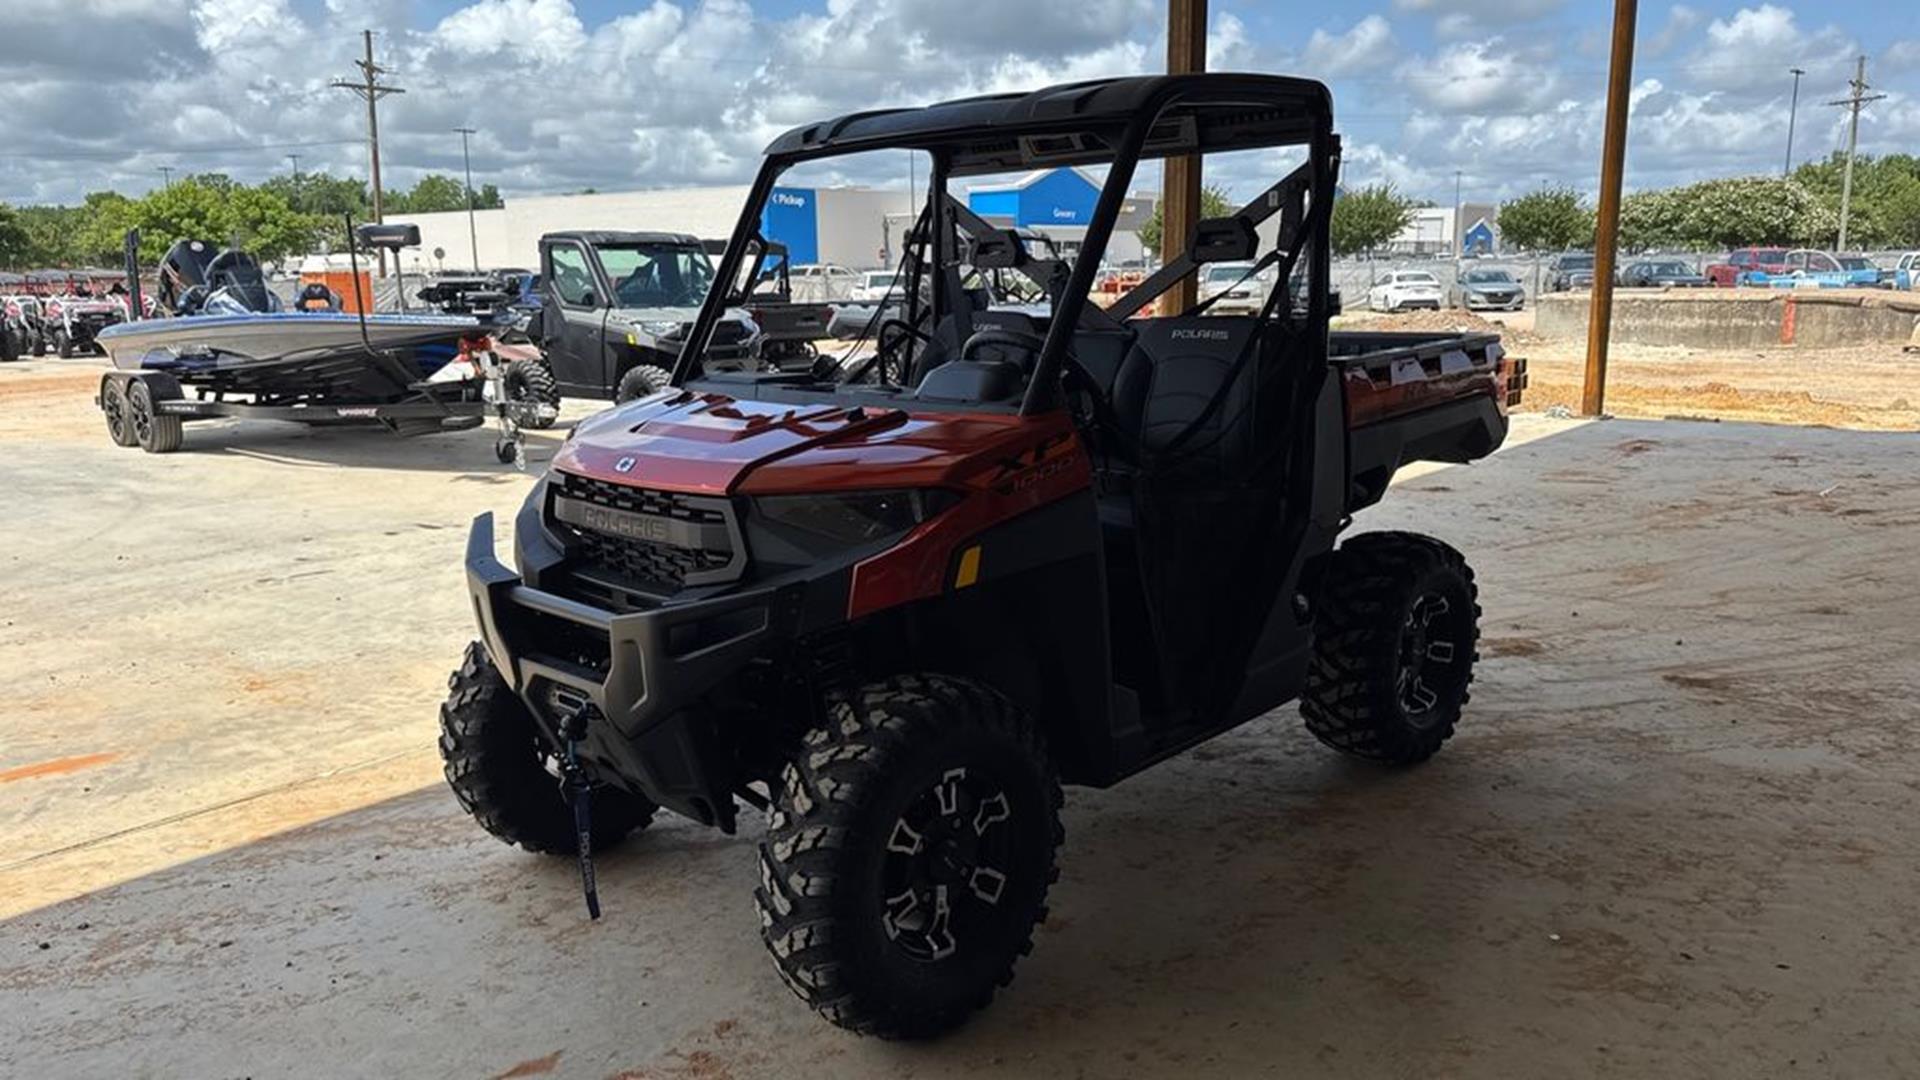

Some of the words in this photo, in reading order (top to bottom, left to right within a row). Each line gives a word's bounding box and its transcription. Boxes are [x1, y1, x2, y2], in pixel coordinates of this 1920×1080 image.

[778, 193, 805, 208] Pickup
[1171, 329, 1229, 340] POLARIS
[585, 507, 666, 539] POLARIS
